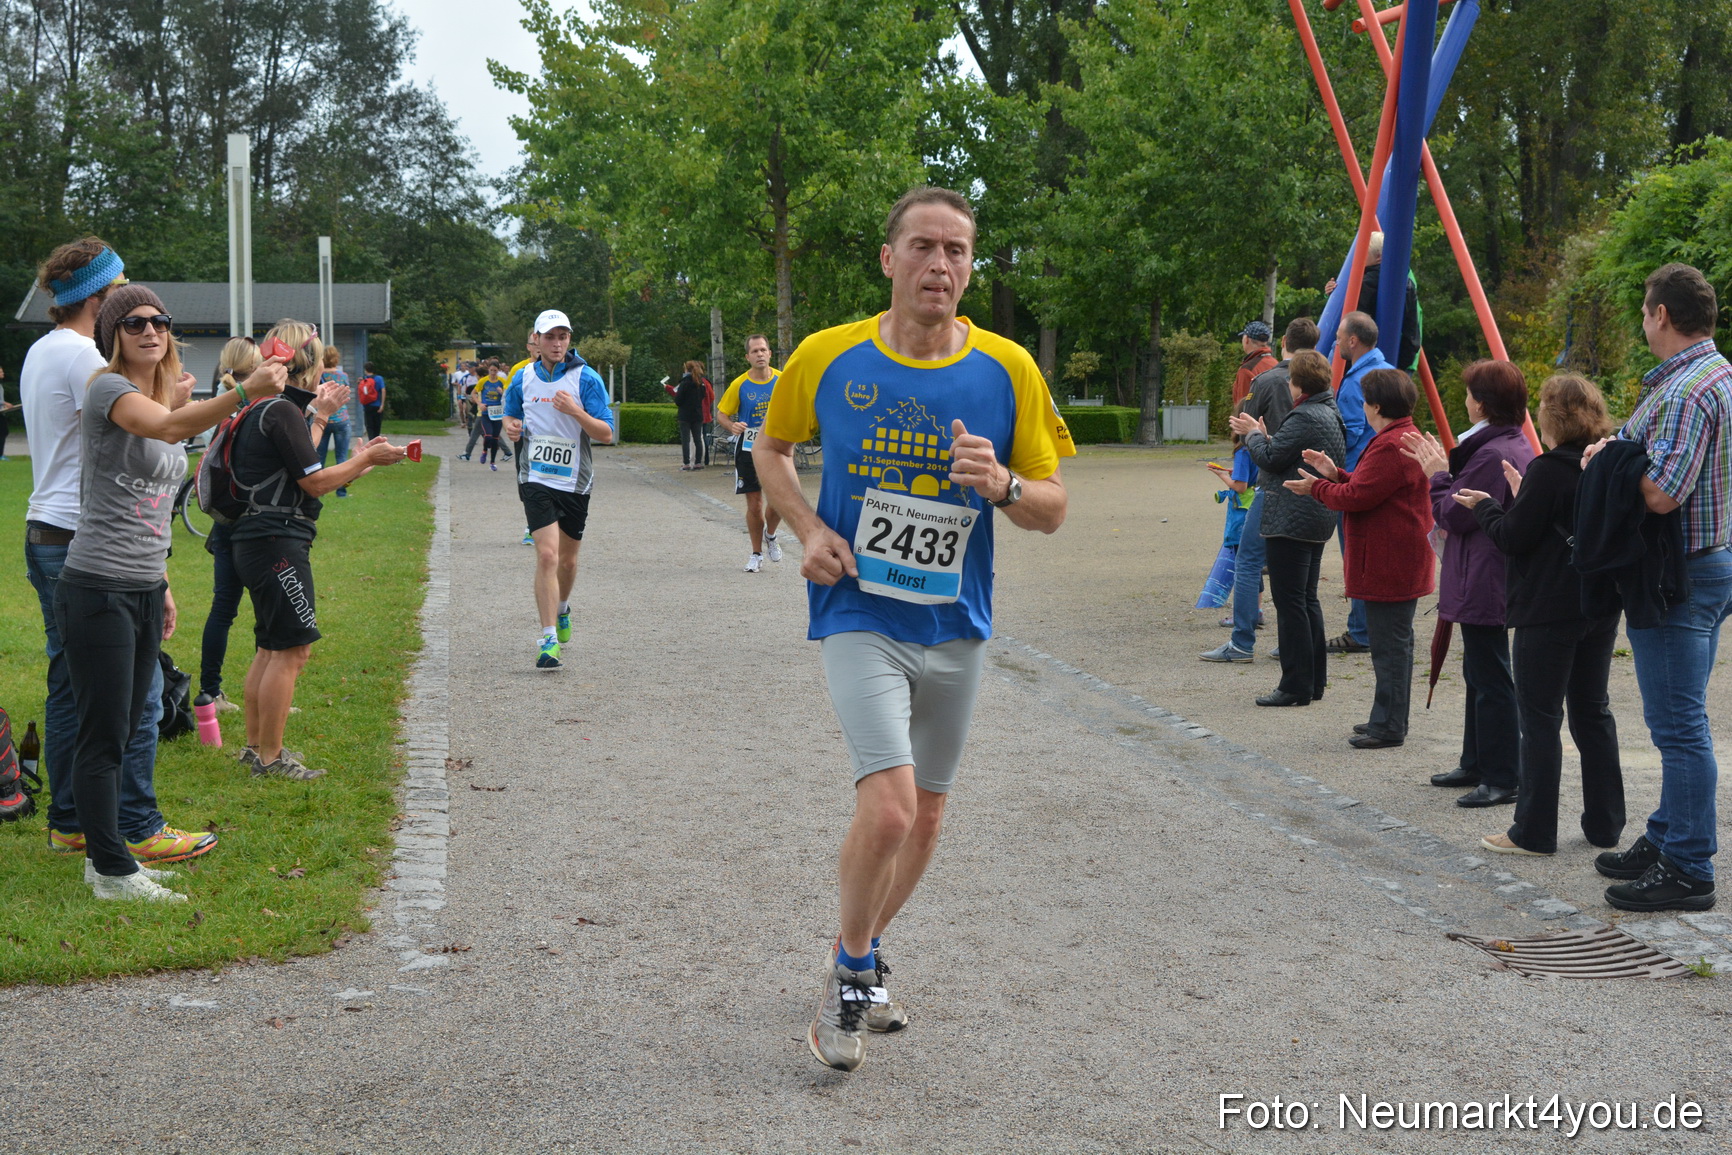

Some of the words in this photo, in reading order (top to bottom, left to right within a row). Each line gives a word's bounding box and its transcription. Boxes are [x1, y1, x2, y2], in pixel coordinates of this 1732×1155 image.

[851, 391, 871, 400] Jahre
[151, 452, 188, 480] NO
[533, 445, 573, 465] 2060
[862, 454, 925, 469] 21.September
[926, 462, 949, 472] 2014
[540, 464, 559, 475] Georg
[866, 497, 903, 516] PARTL
[906, 507, 958, 526] Neumarkt
[865, 516, 959, 567] 2433
[886, 566, 927, 590] Horst
